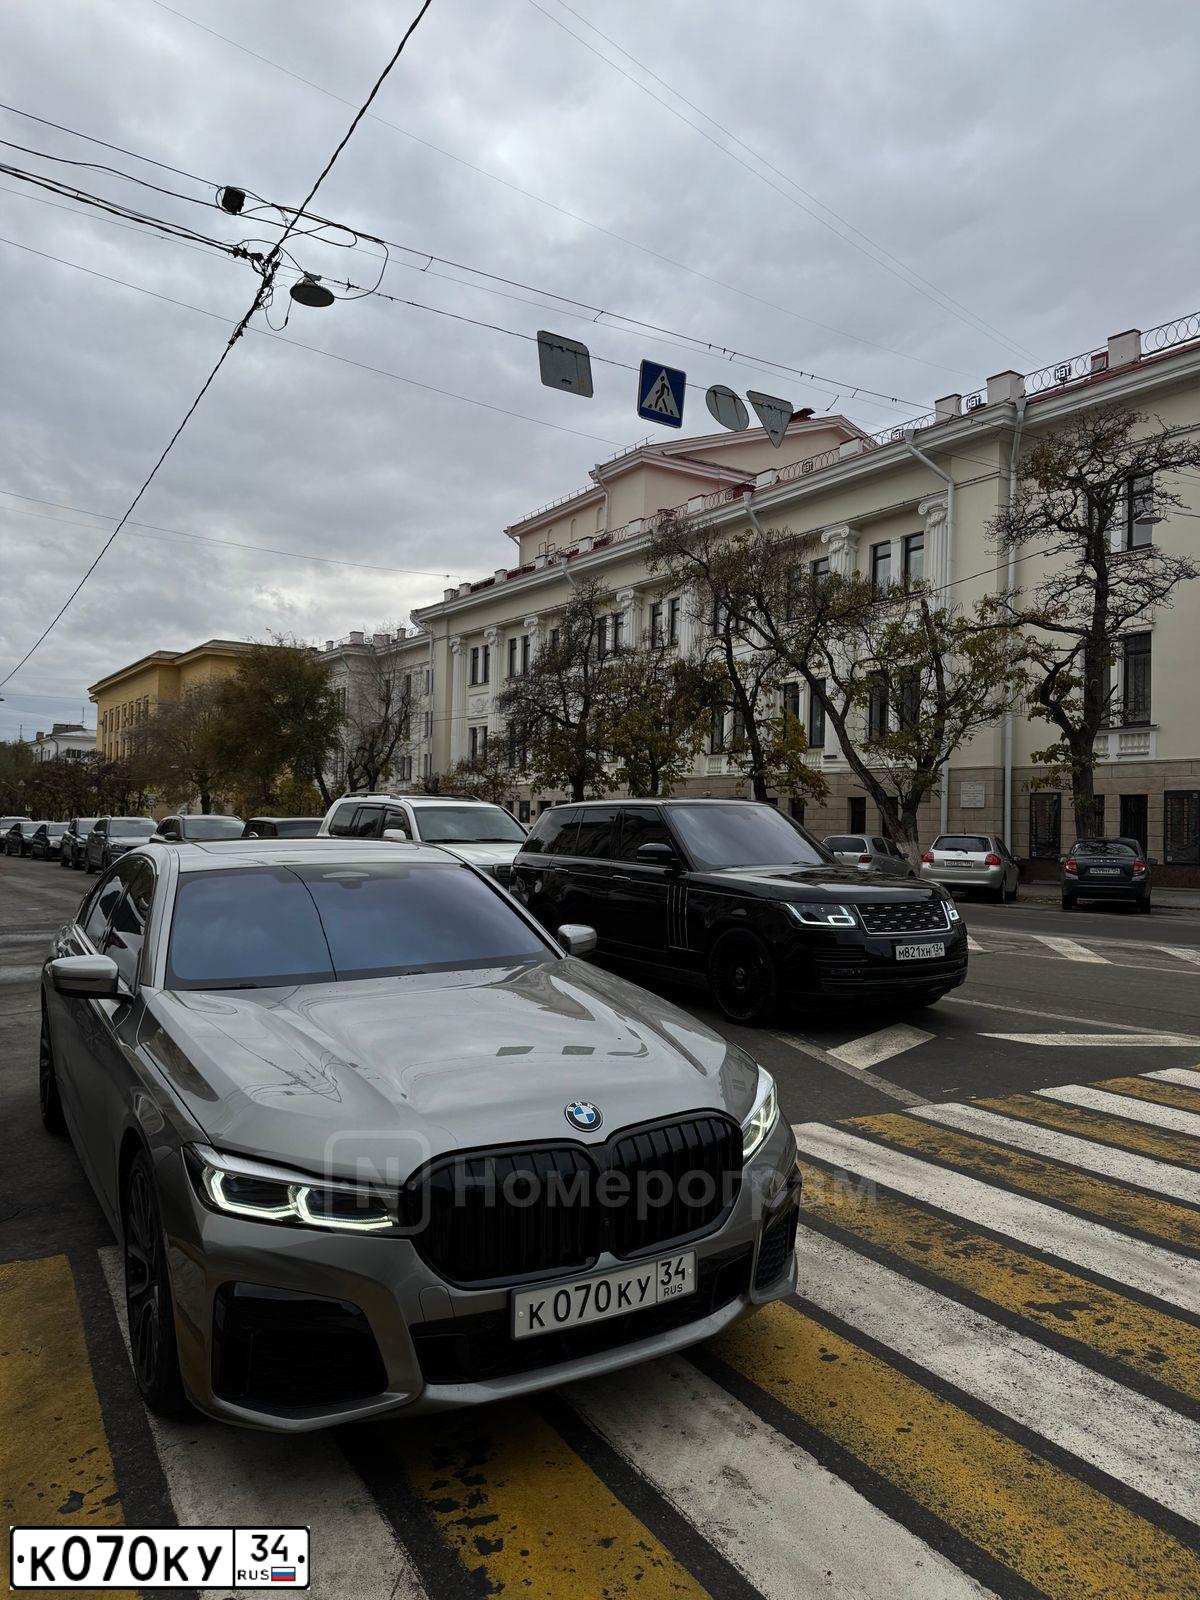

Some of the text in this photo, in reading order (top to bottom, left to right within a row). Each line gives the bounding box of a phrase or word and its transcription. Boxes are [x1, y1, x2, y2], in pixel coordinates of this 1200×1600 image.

[529, 1257, 686, 1330] К070КУ 34
[663, 1284, 683, 1297] RUS
